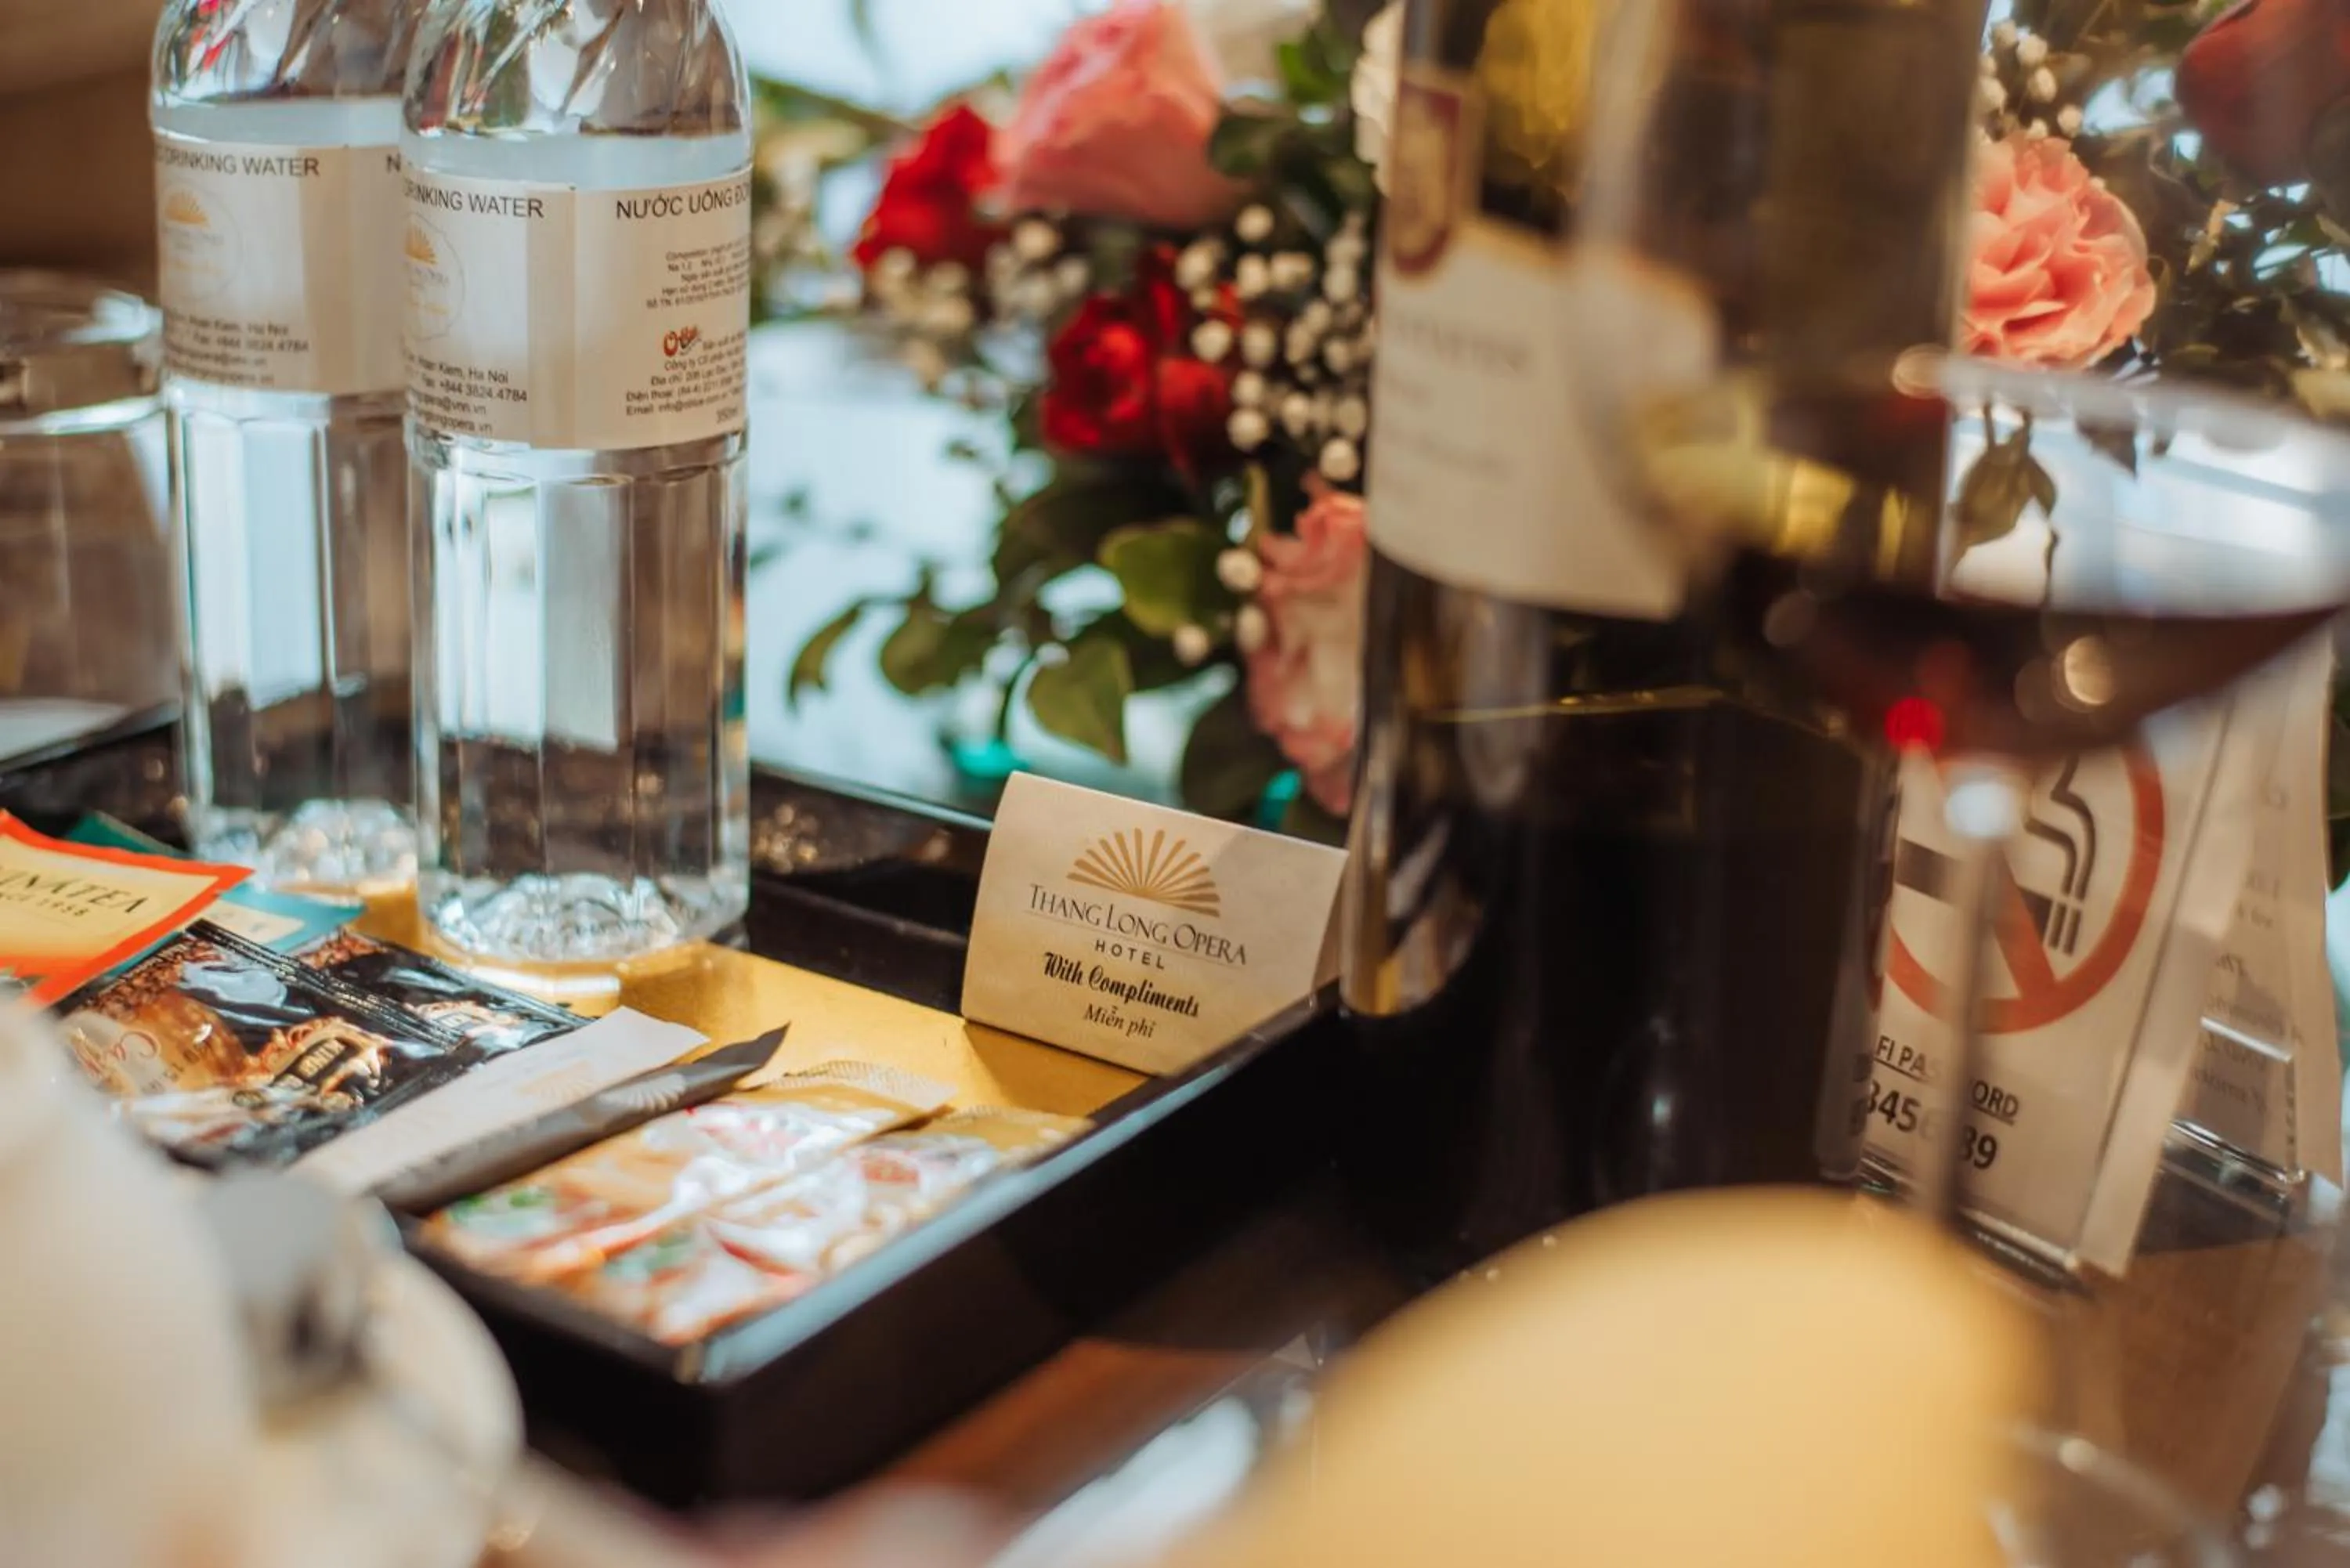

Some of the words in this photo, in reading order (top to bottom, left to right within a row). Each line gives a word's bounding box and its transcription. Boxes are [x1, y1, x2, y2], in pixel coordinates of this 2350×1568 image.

[241, 156, 320, 177] WATER
[468, 193, 544, 219] WATER
[1029, 883, 1103, 926] THANG
[1106, 903, 1170, 945] LONG
[1173, 924, 1247, 965] OPERA
[1095, 940, 1166, 970] HOTEL
[1043, 952, 1084, 985] With
[1089, 964, 1200, 1018] Compliments
[1083, 1003, 1125, 1030] Miễn
[1876, 1034, 1896, 1062] FI
